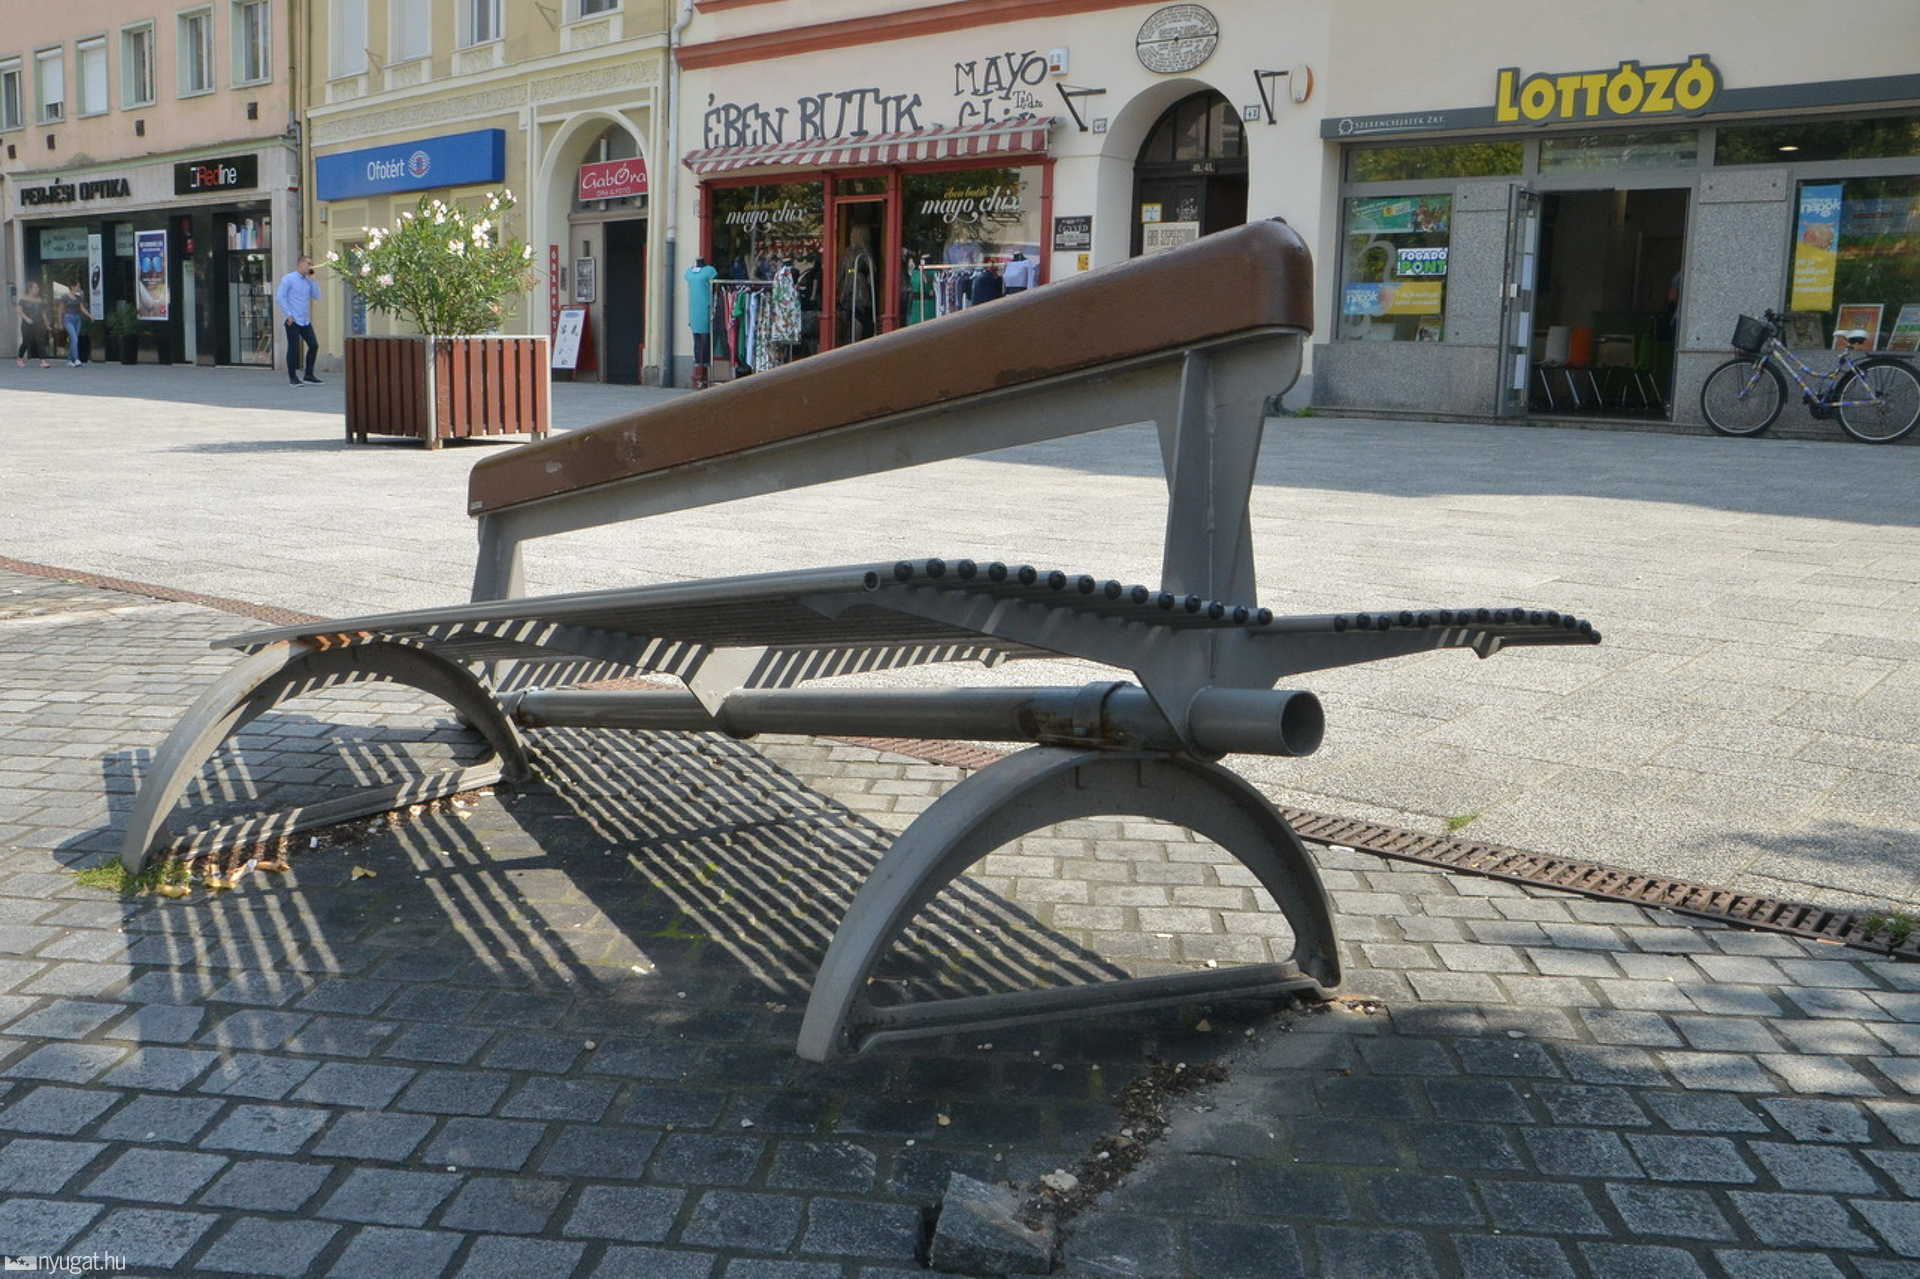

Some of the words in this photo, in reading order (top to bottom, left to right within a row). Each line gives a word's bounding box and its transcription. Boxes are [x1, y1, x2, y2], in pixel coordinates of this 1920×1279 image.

[953, 50, 1047, 99] MAYO
[1497, 58, 1715, 121] LOTTÓZÓ
[704, 93, 789, 148] ÉBEN
[798, 87, 922, 141] BUTIK
[367, 158, 406, 181] Ofotért
[79, 177, 130, 200] OPTIKA
[921, 197, 977, 223] mayo
[1400, 261, 1447, 274] PONT
